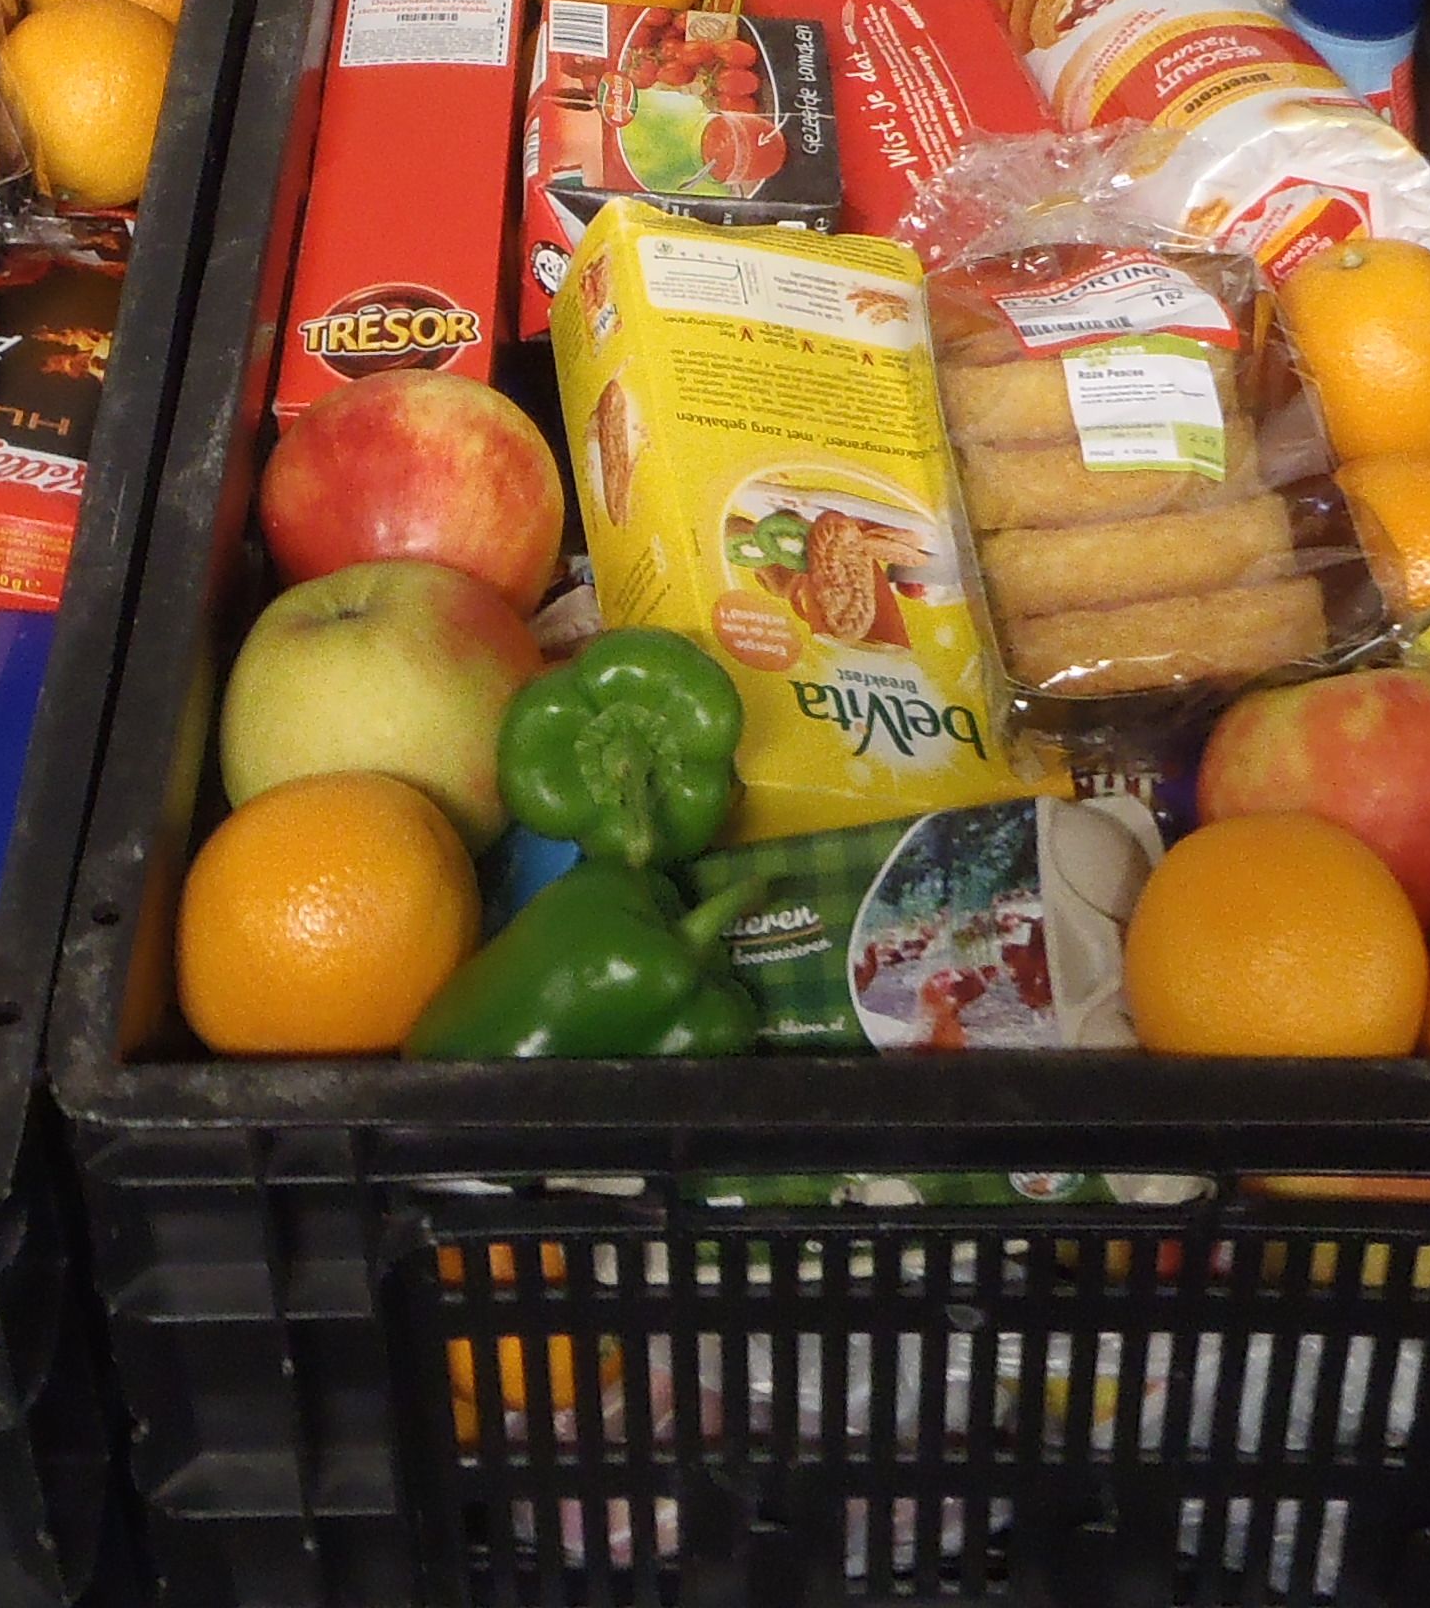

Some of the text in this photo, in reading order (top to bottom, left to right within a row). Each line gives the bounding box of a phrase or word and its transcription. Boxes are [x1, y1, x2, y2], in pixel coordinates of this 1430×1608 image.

[1154, 35, 1239, 80] Naturel
[1154, 44, 1263, 99] BESCHUIT
[795, 24, 823, 155] Gezeefde tomaten
[859, 89, 898, 113] je
[870, 119, 920, 169] Wist
[676, 411, 748, 431] gebakken
[750, 420, 783, 438] zorg
[835, 666, 919, 695] Breakfast
[787, 676, 987, 761] belVita
